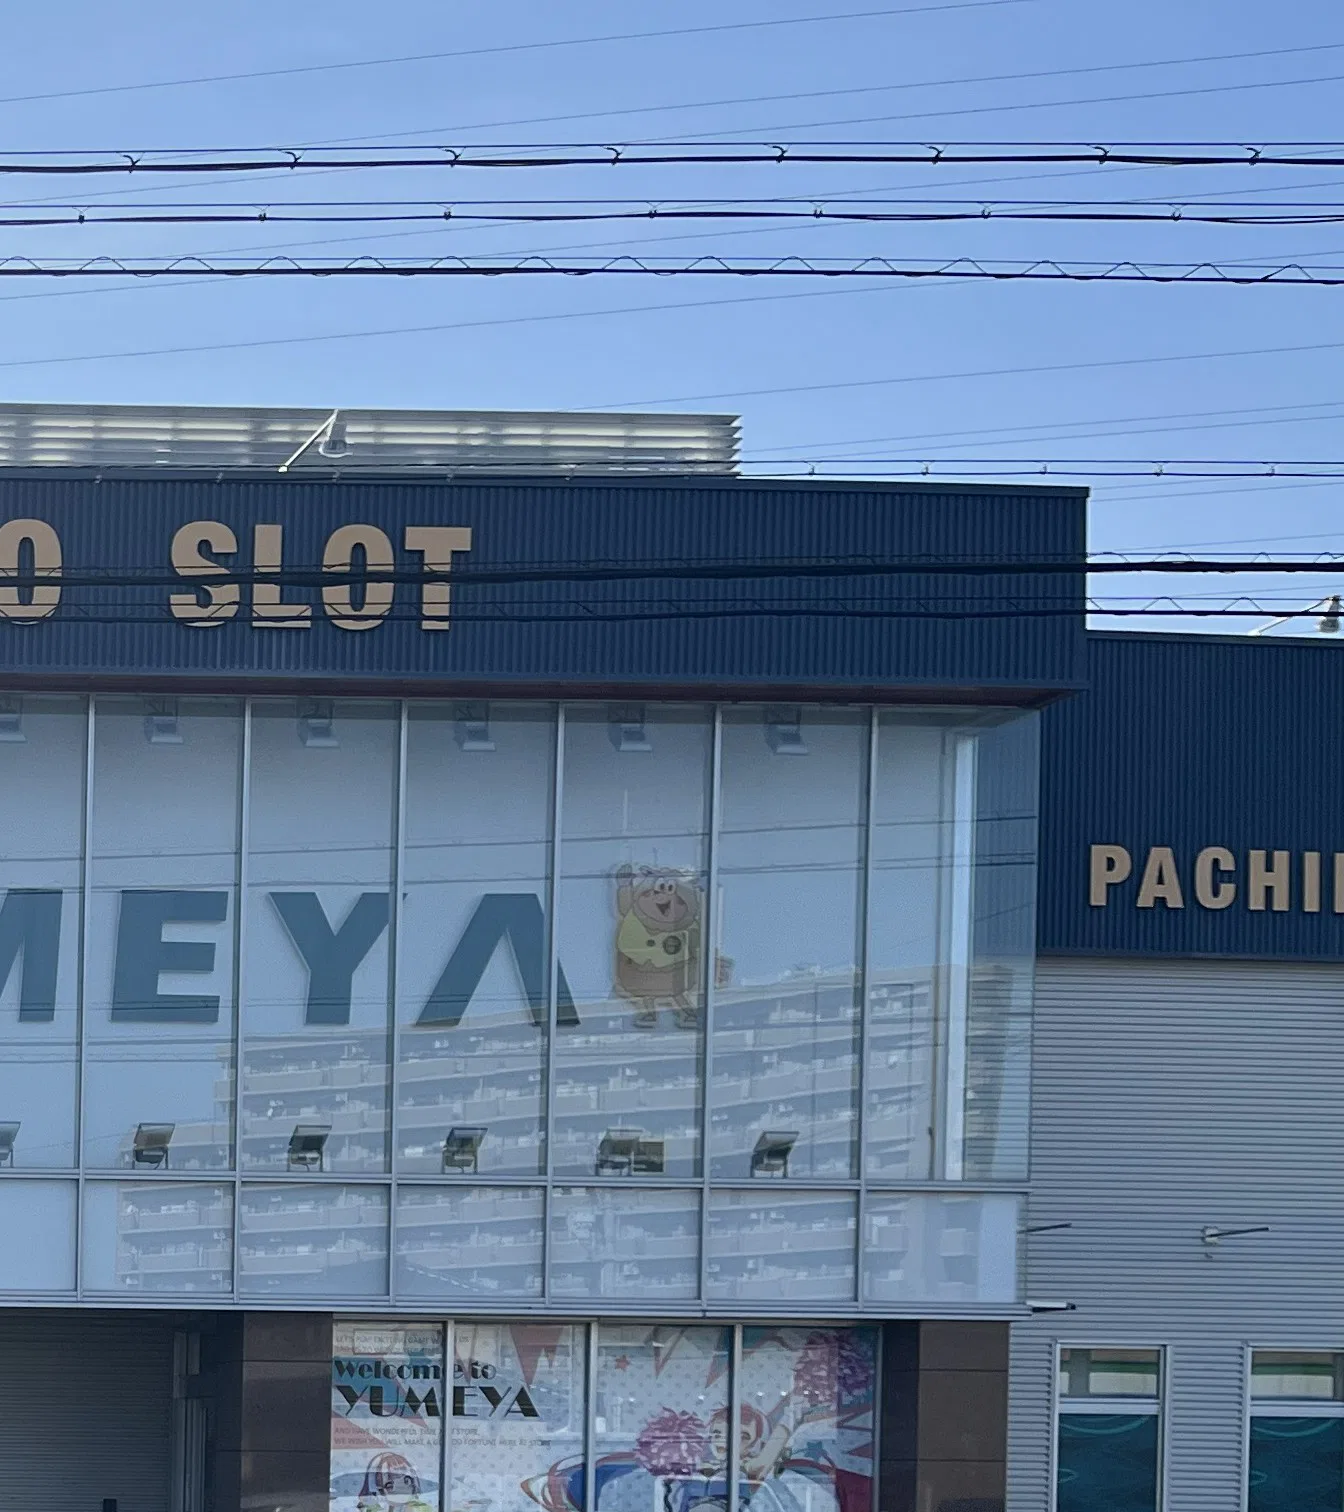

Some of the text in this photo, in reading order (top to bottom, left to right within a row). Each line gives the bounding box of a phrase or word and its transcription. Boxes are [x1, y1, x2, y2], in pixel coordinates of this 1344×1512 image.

[169, 518, 473, 632] SLOT
[1088, 843, 1344, 914] PACHI
[334, 1359, 497, 1380] Welcome to
[335, 1384, 540, 1418] YUMEYA
